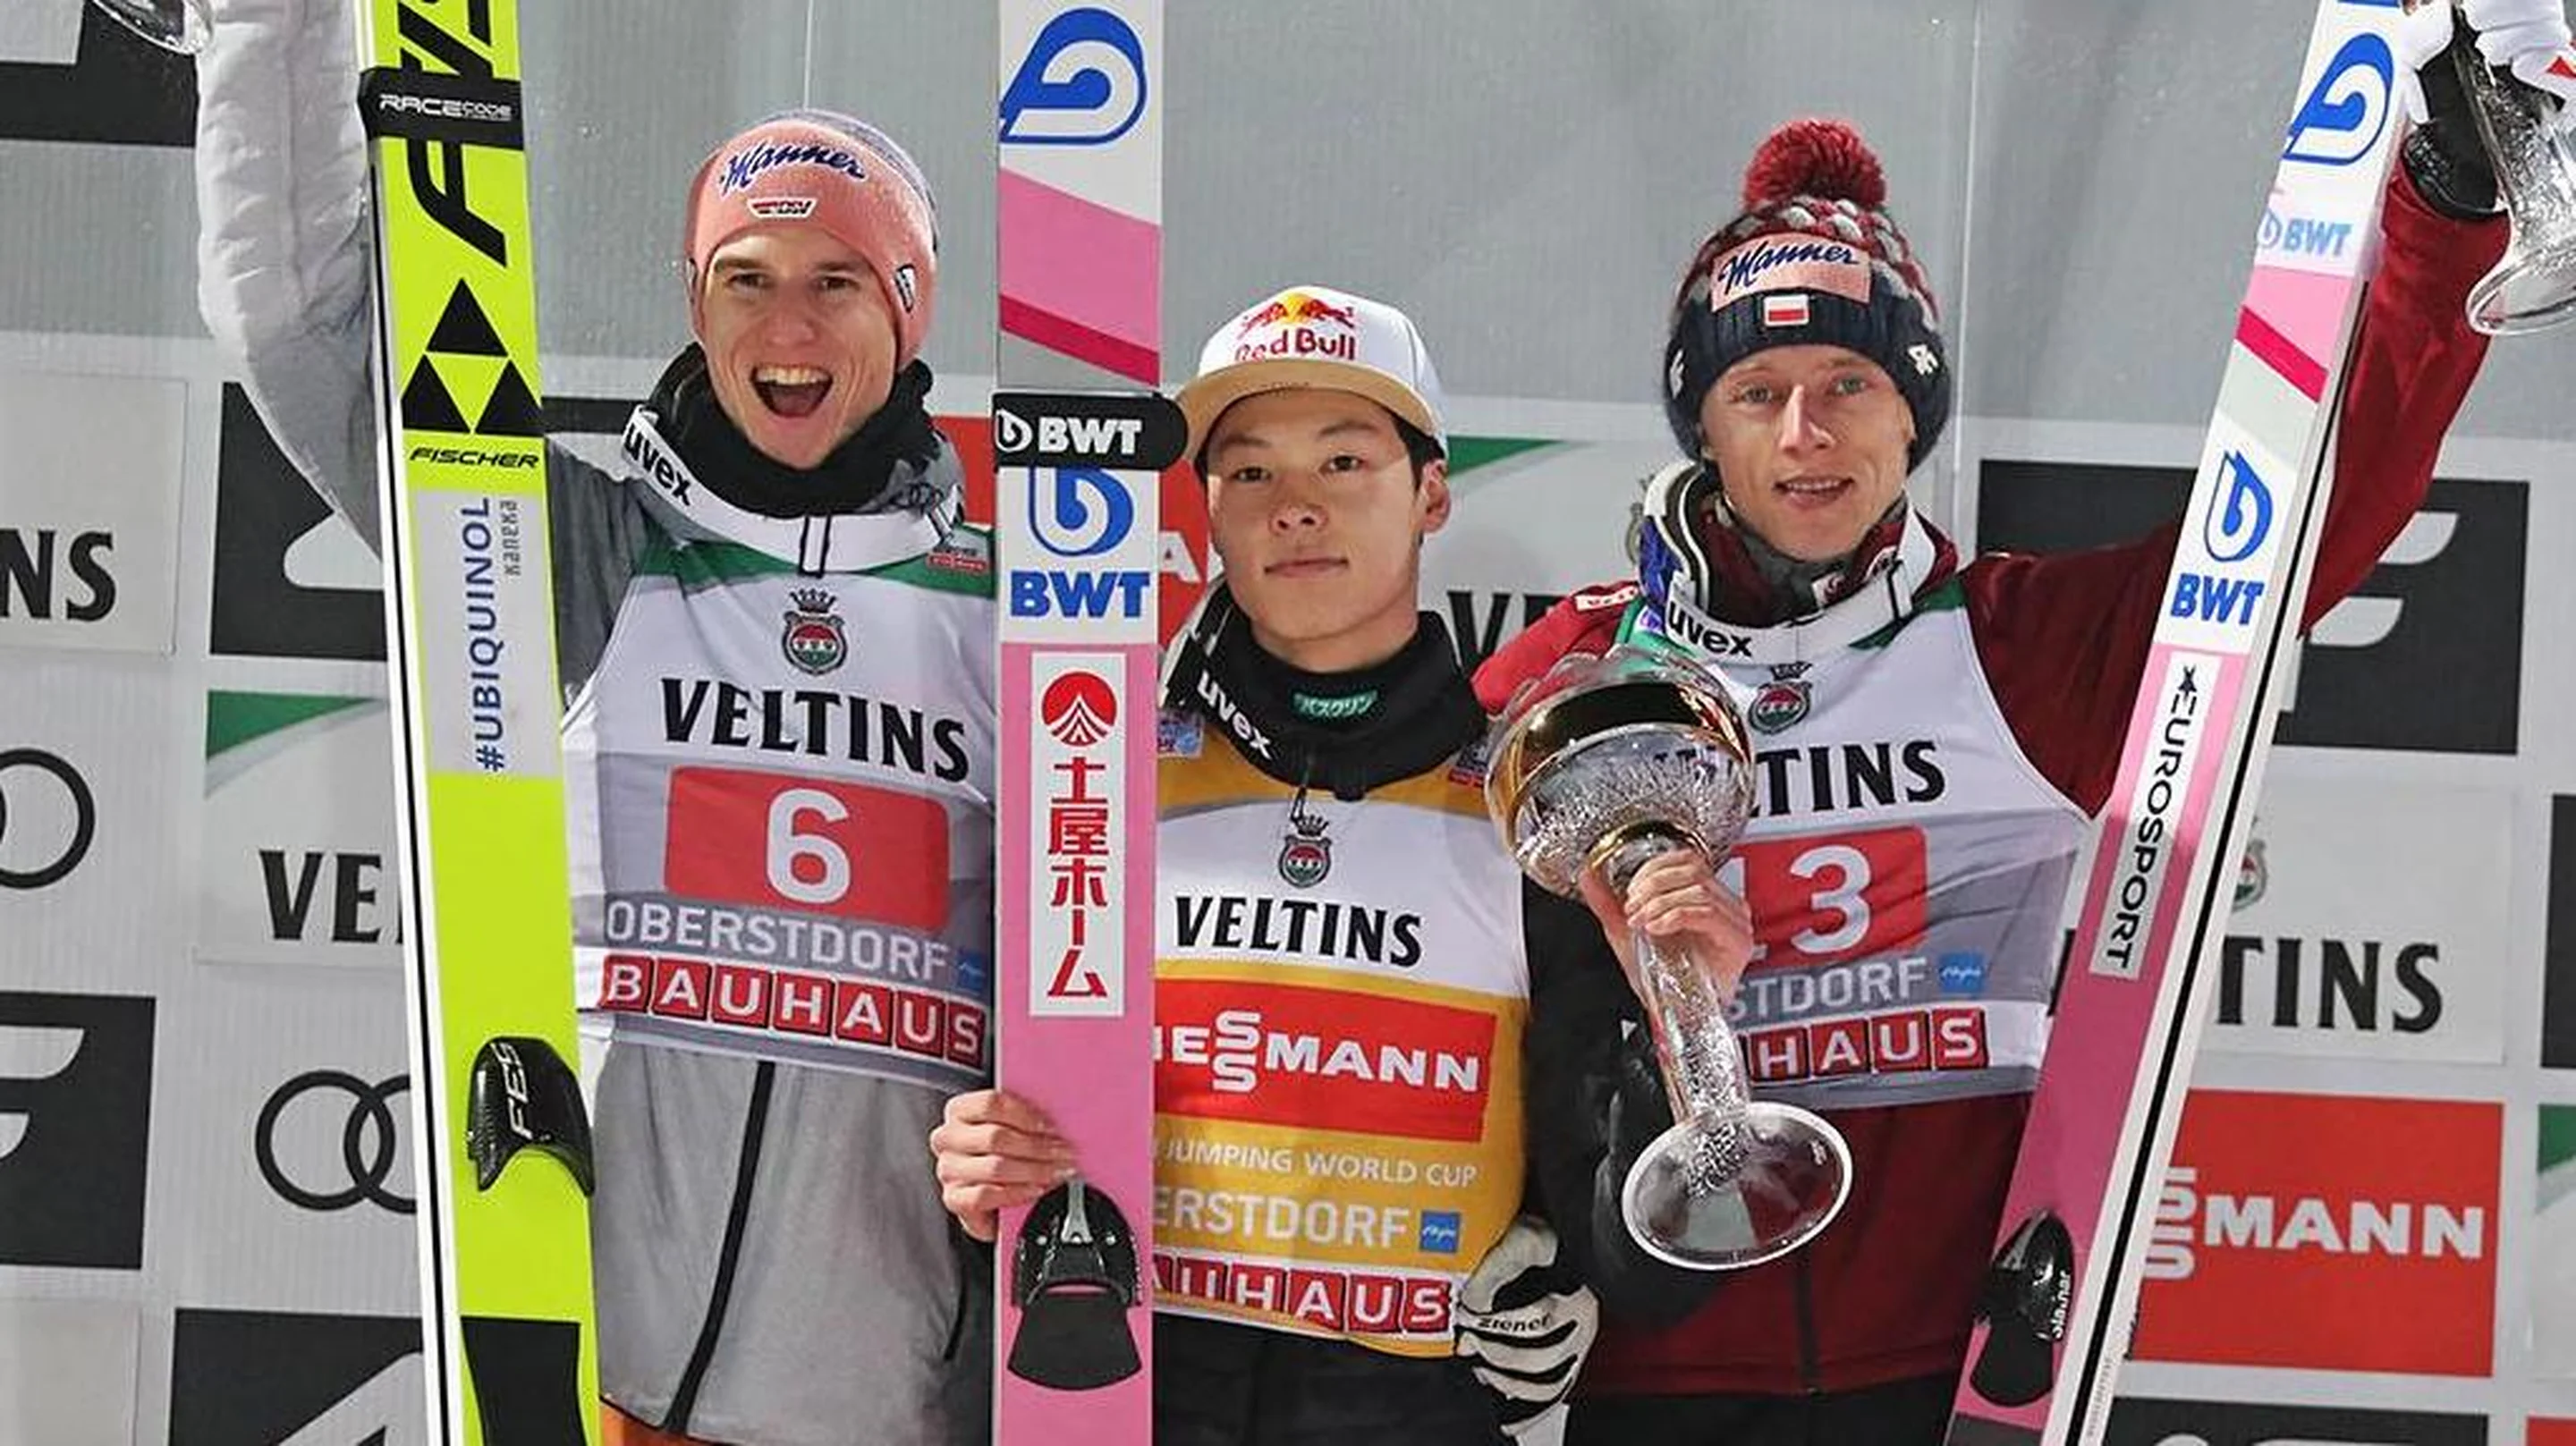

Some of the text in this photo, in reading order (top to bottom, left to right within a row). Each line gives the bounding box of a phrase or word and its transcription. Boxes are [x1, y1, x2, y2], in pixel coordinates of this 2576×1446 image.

[719, 140, 866, 198] Manner
[1717, 241, 1860, 296] Manner
[2284, 218, 2353, 256] BWT
[1296, 327, 1356, 360] Bull
[410, 446, 540, 469] FISCHER
[625, 423, 692, 506] uvex
[1038, 417, 1142, 455] BWT
[1010, 570, 1151, 619] BWT
[1667, 602, 1754, 658] uvex
[2170, 573, 2266, 625] BWT
[460, 497, 504, 774] #UBIQUINOL
[660, 677, 970, 783] VELTINS
[1197, 670, 1273, 760] uvex
[1750, 740, 1946, 817] TINS
[766, 788, 852, 904] 6
[2106, 684, 2199, 969] EUROSPORT
[258, 850, 402, 944] VE
[1047, 757, 1110, 998] 土屋ホーム
[606, 901, 950, 981] OBERSTDORF
[1174, 895, 1424, 968] VELTINS
[606, 962, 981, 1055] BAUHAUS
[1757, 1016, 1979, 1077] HAUS
[1166, 1137, 1479, 1188] JUMPING WORLD CUP
